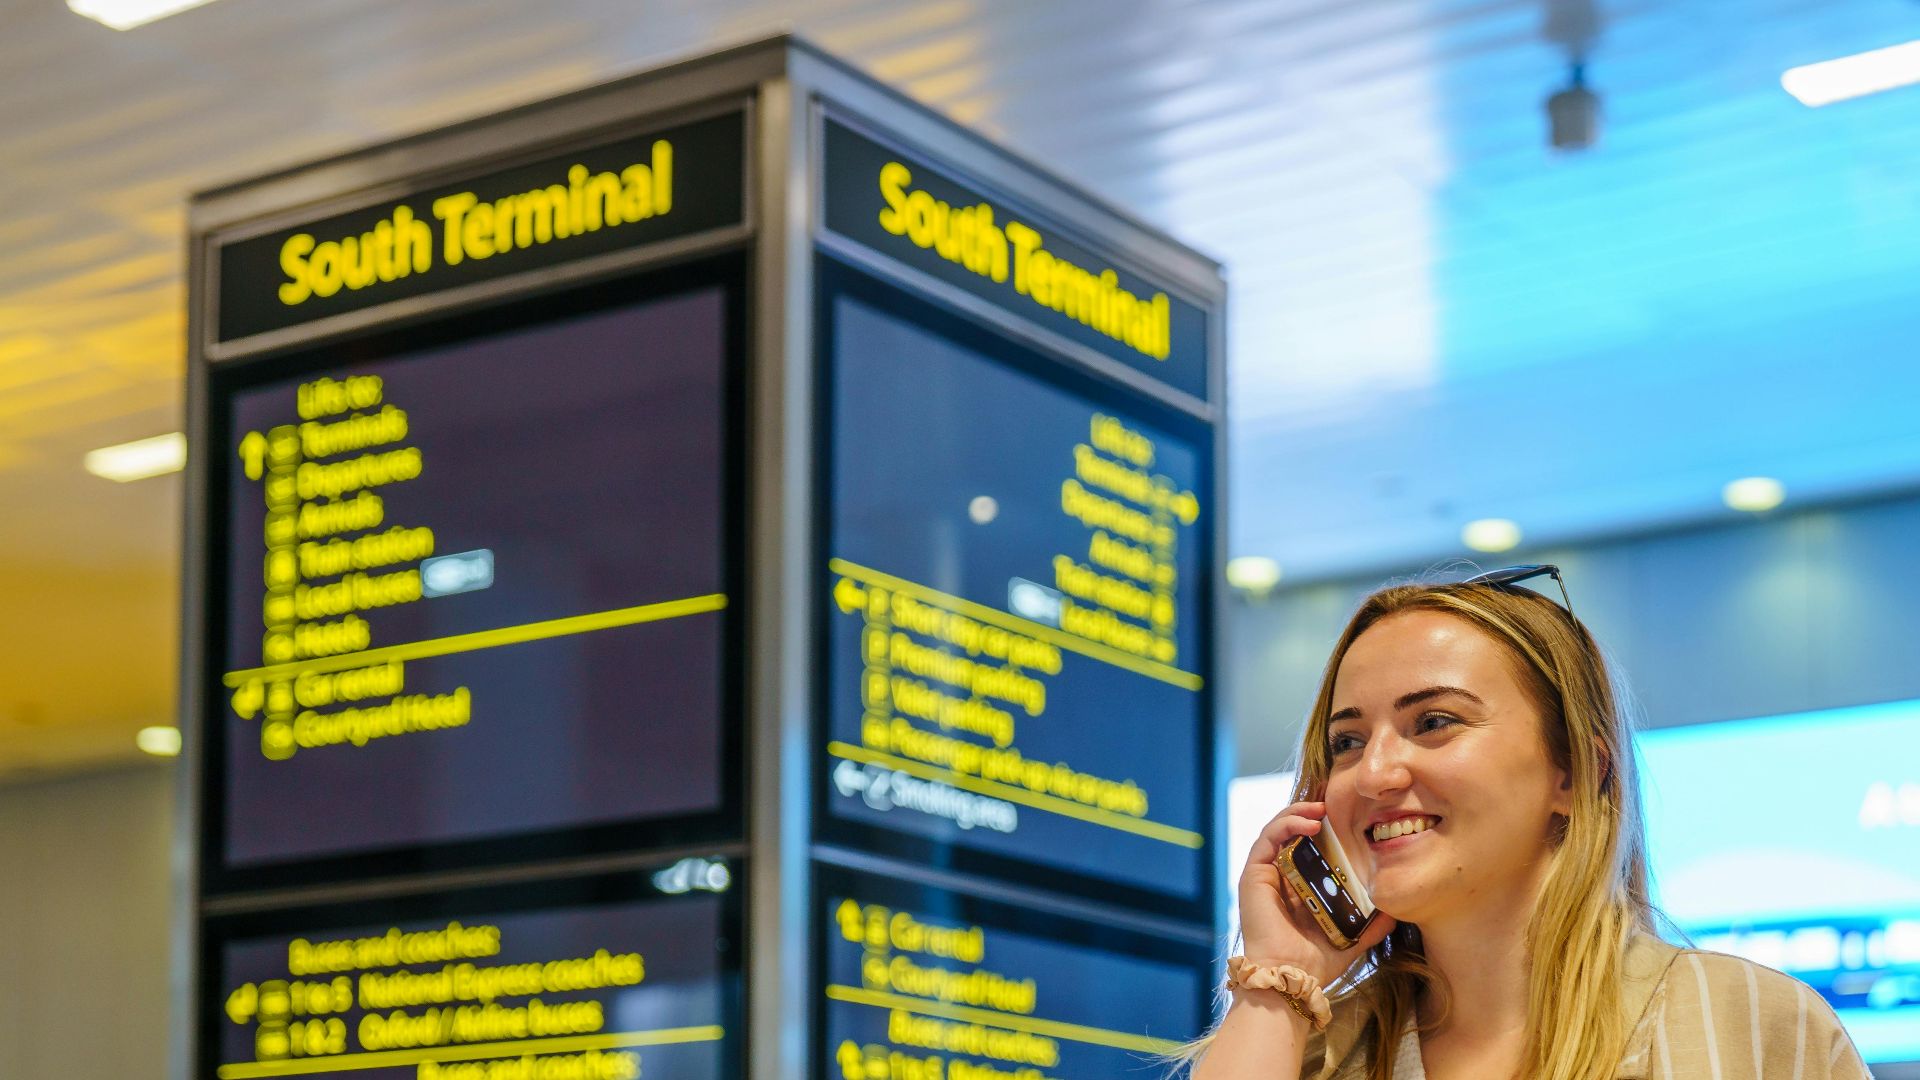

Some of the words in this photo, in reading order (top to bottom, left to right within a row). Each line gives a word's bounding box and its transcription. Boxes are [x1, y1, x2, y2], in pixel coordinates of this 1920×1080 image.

[279, 205, 431, 305] South
[433, 139, 672, 265] Terminal
[879, 162, 1009, 283] South
[1006, 221, 1170, 360] Terminal
[299, 448, 421, 499] Departures
[299, 491, 382, 538] Arrivals
[299, 540, 351, 577] Train
[352, 527, 433, 568] station
[296, 574, 354, 619] Local
[354, 569, 421, 609] buses
[295, 614, 370, 656] Hotels
[892, 590, 940, 635] Short
[980, 625, 1009, 661] car
[294, 671, 333, 707] Car
[334, 658, 404, 701] rental
[891, 632, 973, 688] Premium
[973, 664, 1045, 716] parking
[294, 697, 402, 747] Courtyard
[402, 686, 471, 731] Hotel
[892, 676, 940, 723] Valet
[940, 695, 1014, 748] parking
[891, 717, 982, 778] Passenger
[891, 770, 974, 830] Smoking
[974, 796, 1017, 833] area
[289, 938, 353, 975] Buses
[353, 927, 399, 969] and
[890, 912, 926, 953] Car
[925, 924, 984, 964] rental
[359, 965, 455, 1009] National
[455, 963, 544, 1004] Express
[544, 949, 644, 993] coaches
[890, 956, 982, 1007] Courtyard
[983, 971, 1036, 1014] Hotel
[359, 1007, 440, 1050] Oxford
[528, 999, 604, 1038] buses
[888, 1009, 945, 1050] Buses
[945, 1022, 984, 1056] and
